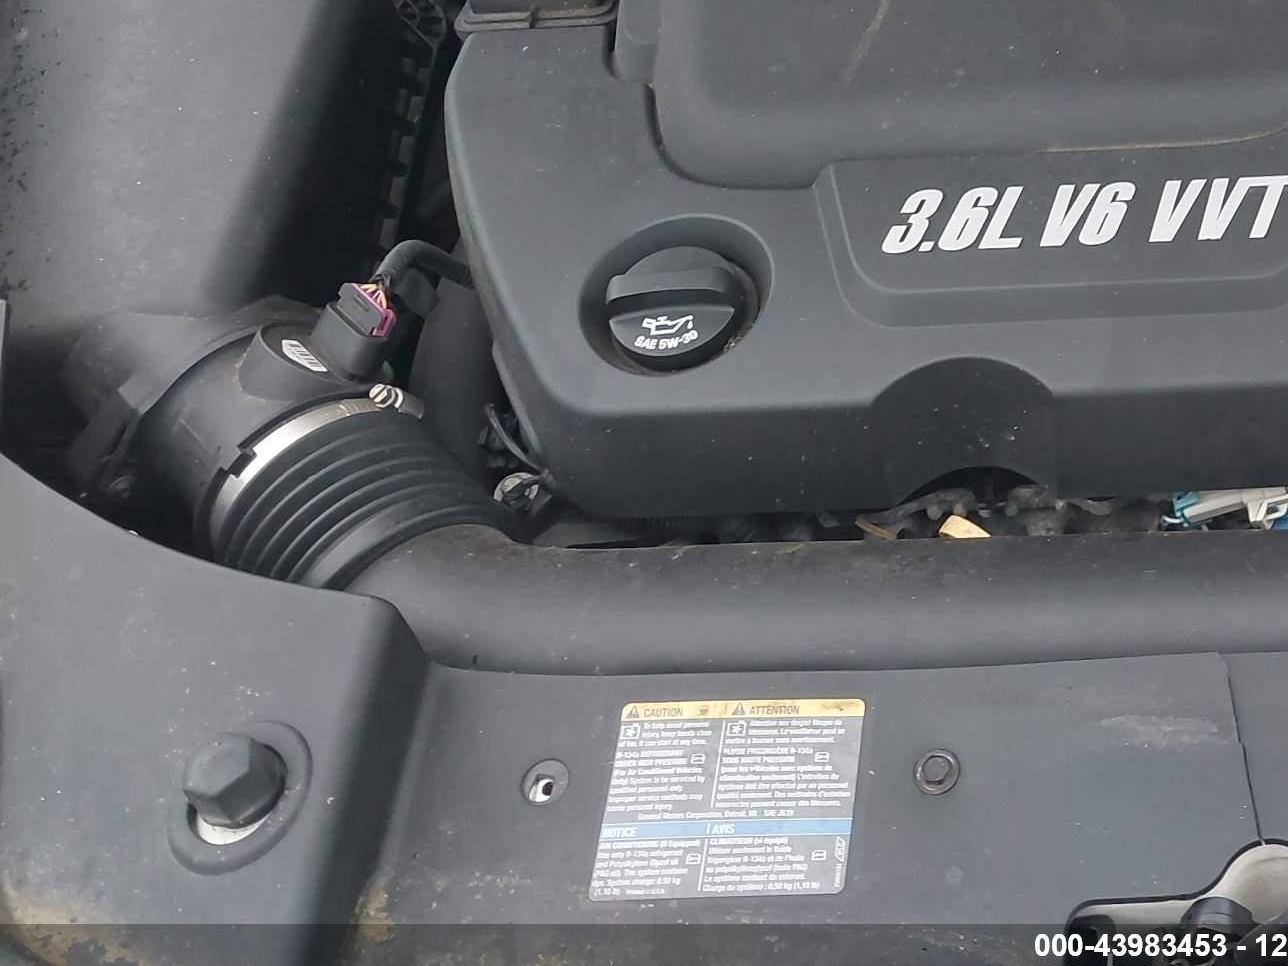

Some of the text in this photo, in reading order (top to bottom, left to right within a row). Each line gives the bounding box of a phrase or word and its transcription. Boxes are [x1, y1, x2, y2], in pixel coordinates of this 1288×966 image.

[881, 185, 1024, 254] 3.6L
[1039, 181, 1136, 248] V6
[634, 329, 699, 350] SAE 5W-30
[643, 707, 683, 718] CAUTION
[749, 705, 800, 715] ATTENTION
[601, 826, 637, 837] NOTICE
[711, 824, 735, 834] AVIS
